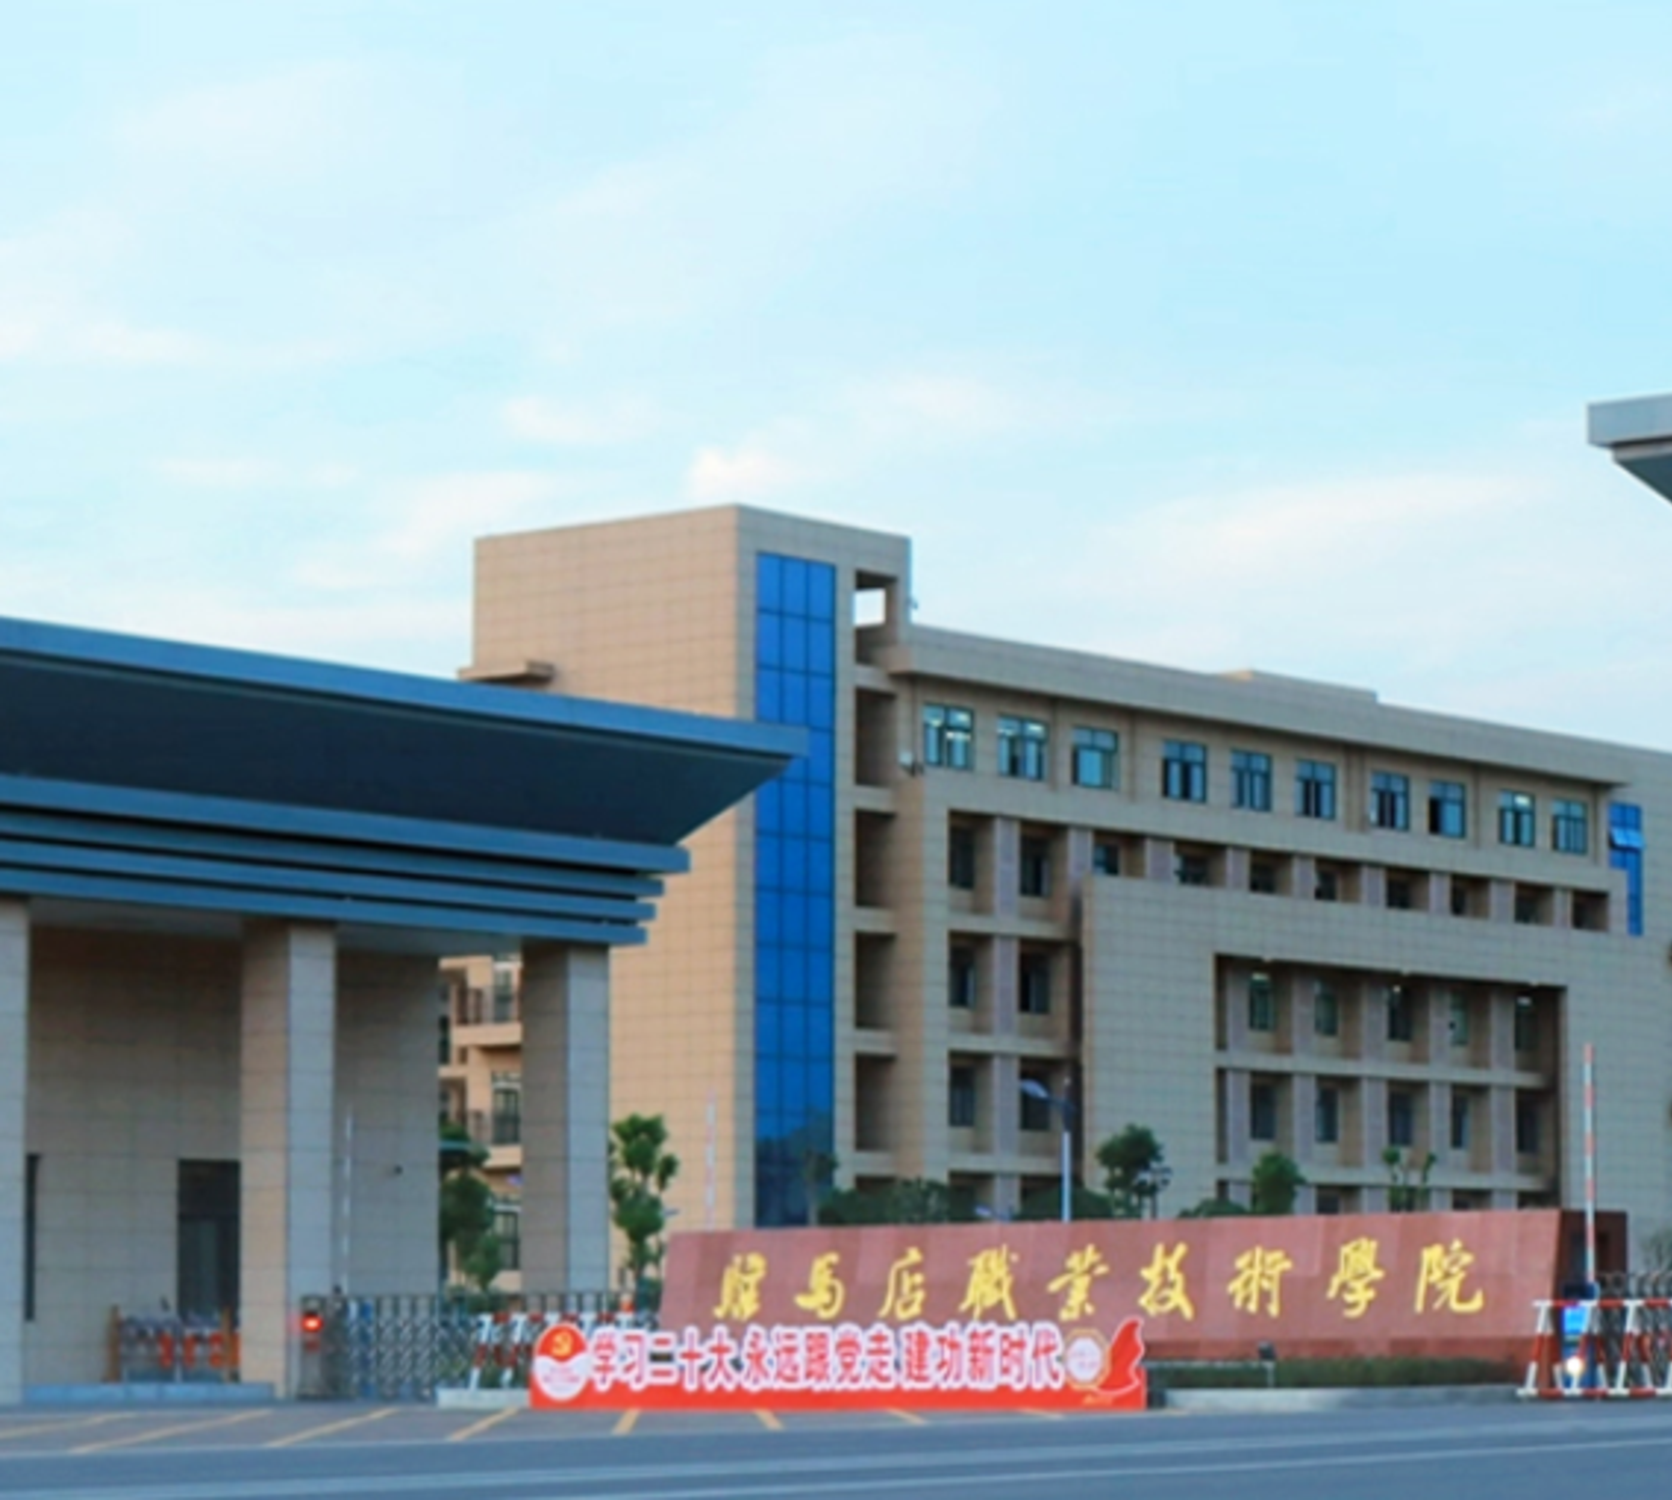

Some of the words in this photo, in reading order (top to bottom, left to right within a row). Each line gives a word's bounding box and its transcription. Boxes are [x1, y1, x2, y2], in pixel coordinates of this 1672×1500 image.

[591, 1327, 735, 1390] 学习二十大
[742, 1327, 893, 1389] 永远跟党走
[903, 1326, 1062, 1388] 建功新时代
